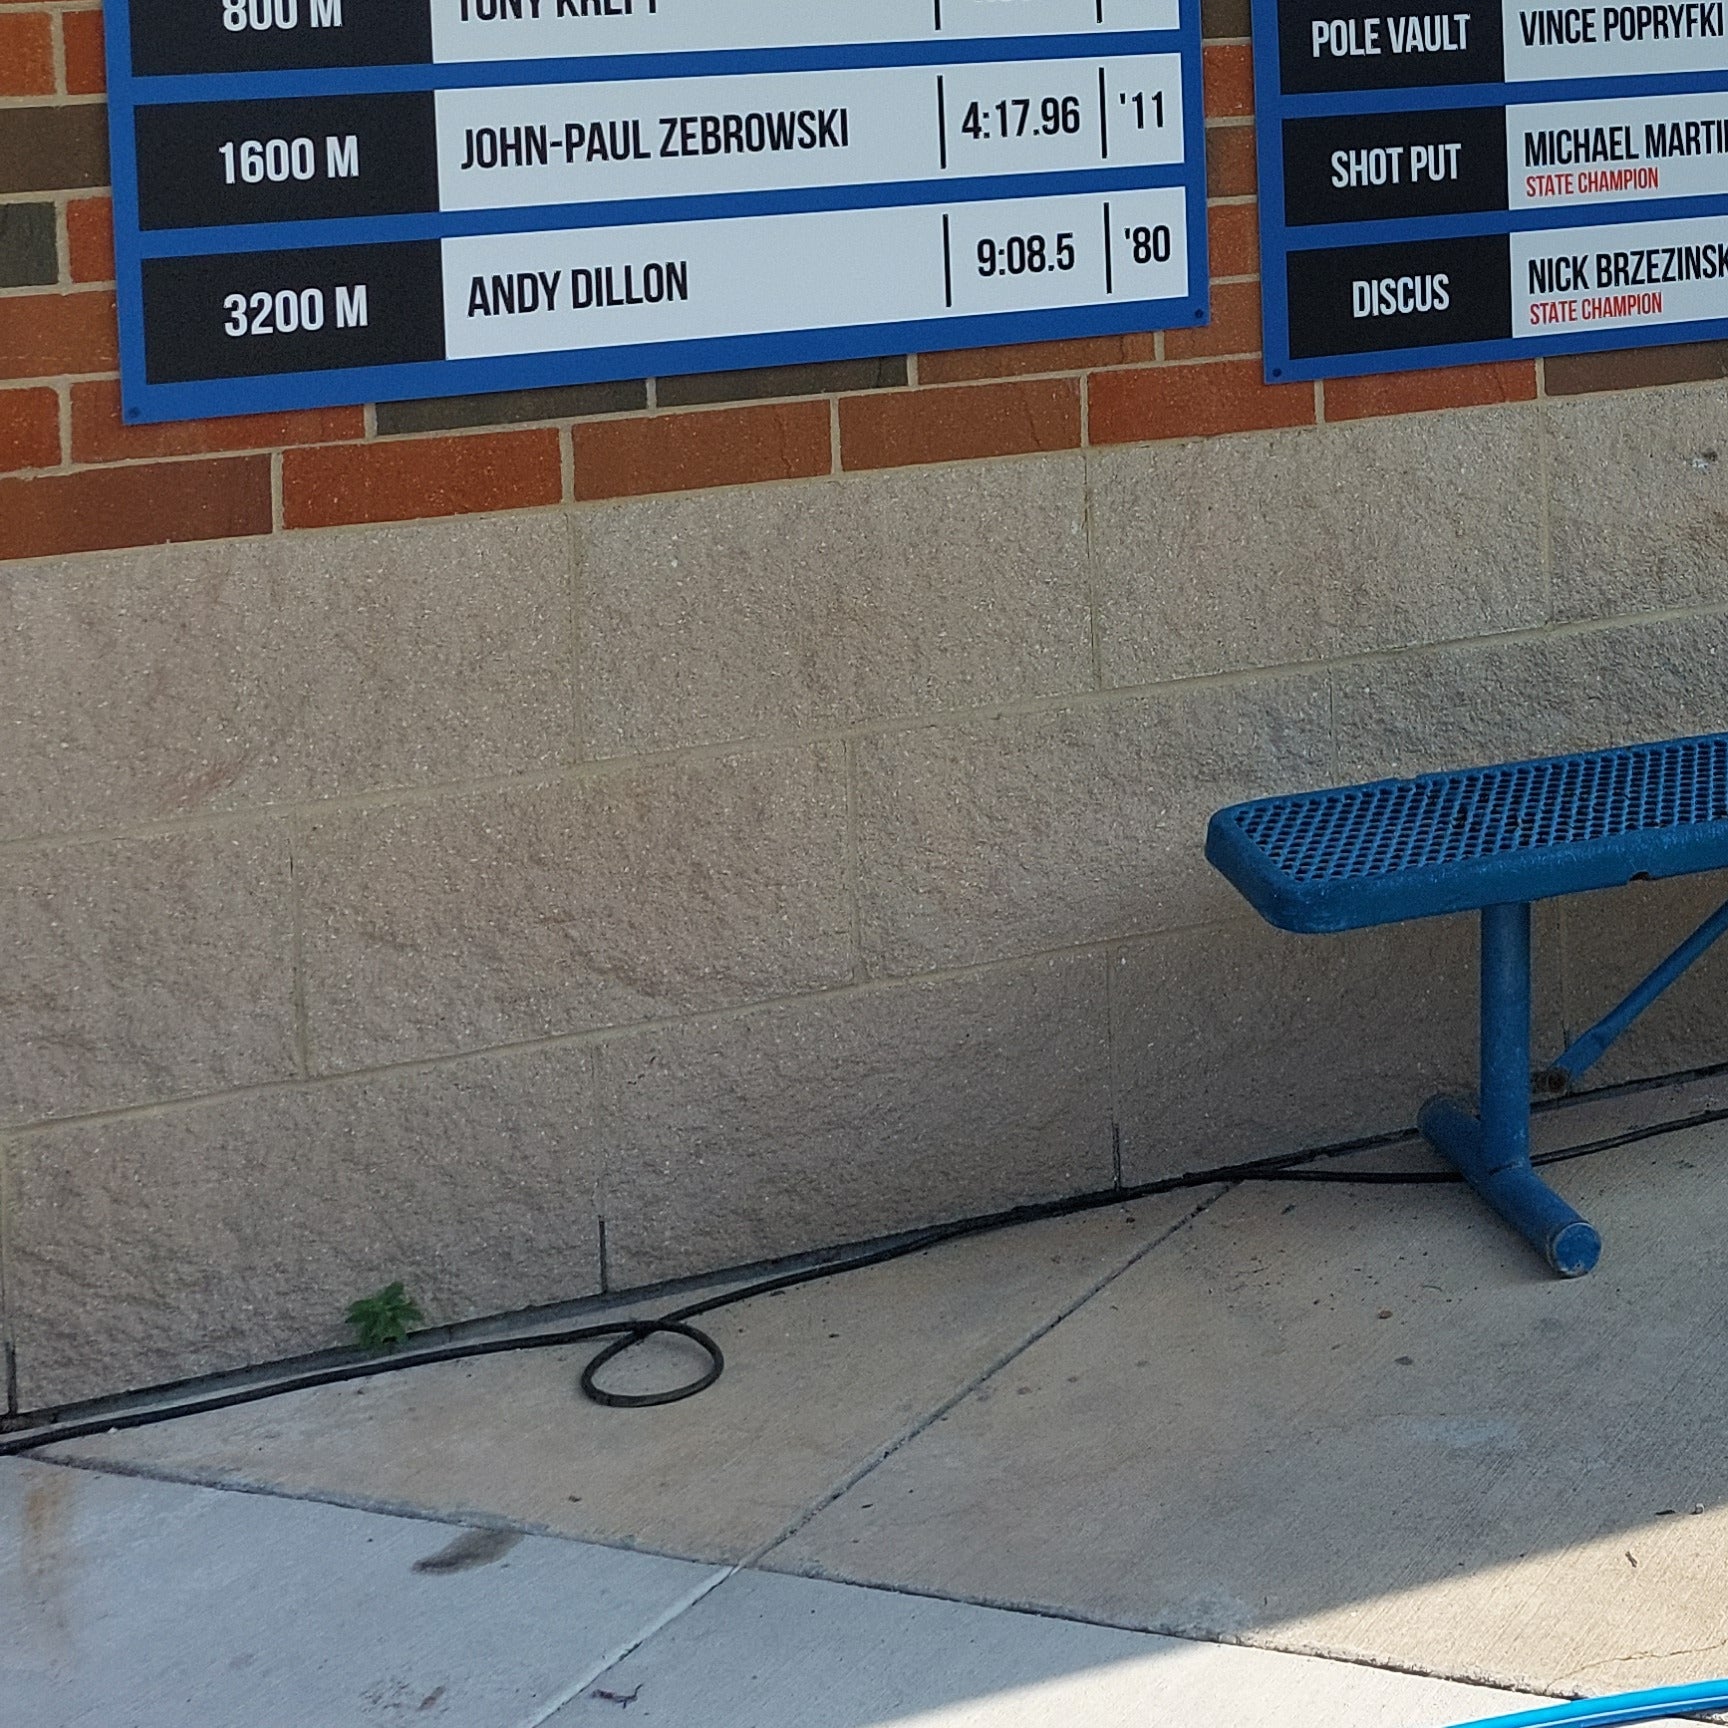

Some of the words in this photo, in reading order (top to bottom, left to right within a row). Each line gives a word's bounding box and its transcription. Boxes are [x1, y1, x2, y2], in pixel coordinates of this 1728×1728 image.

[1312, 18, 1381, 57] POLE
[1387, 14, 1470, 53] VAULT
[1519, 8, 1597, 46] VINCE
[1604, 2, 1723, 42] POPRYFKI
[962, 96, 1080, 139] 4:17.96
[1120, 91, 1163, 129] '11
[219, 138, 315, 184] 1600
[326, 135, 359, 178] M
[461, 120, 651, 170] JOHN-PAUL
[659, 108, 848, 157] ZEBROWSKI
[977, 233, 1074, 277] 9:08.5
[1125, 225, 1170, 264] '80
[468, 270, 561, 317] ANDY
[571, 261, 688, 309] DILLON
[1353, 274, 1449, 317] DISCUS
[1529, 255, 1590, 294] NICK
[224, 288, 324, 336] 3200
[335, 285, 368, 328] M
[1530, 300, 1578, 325] STATE
[1582, 292, 1662, 320] CHAMPION
